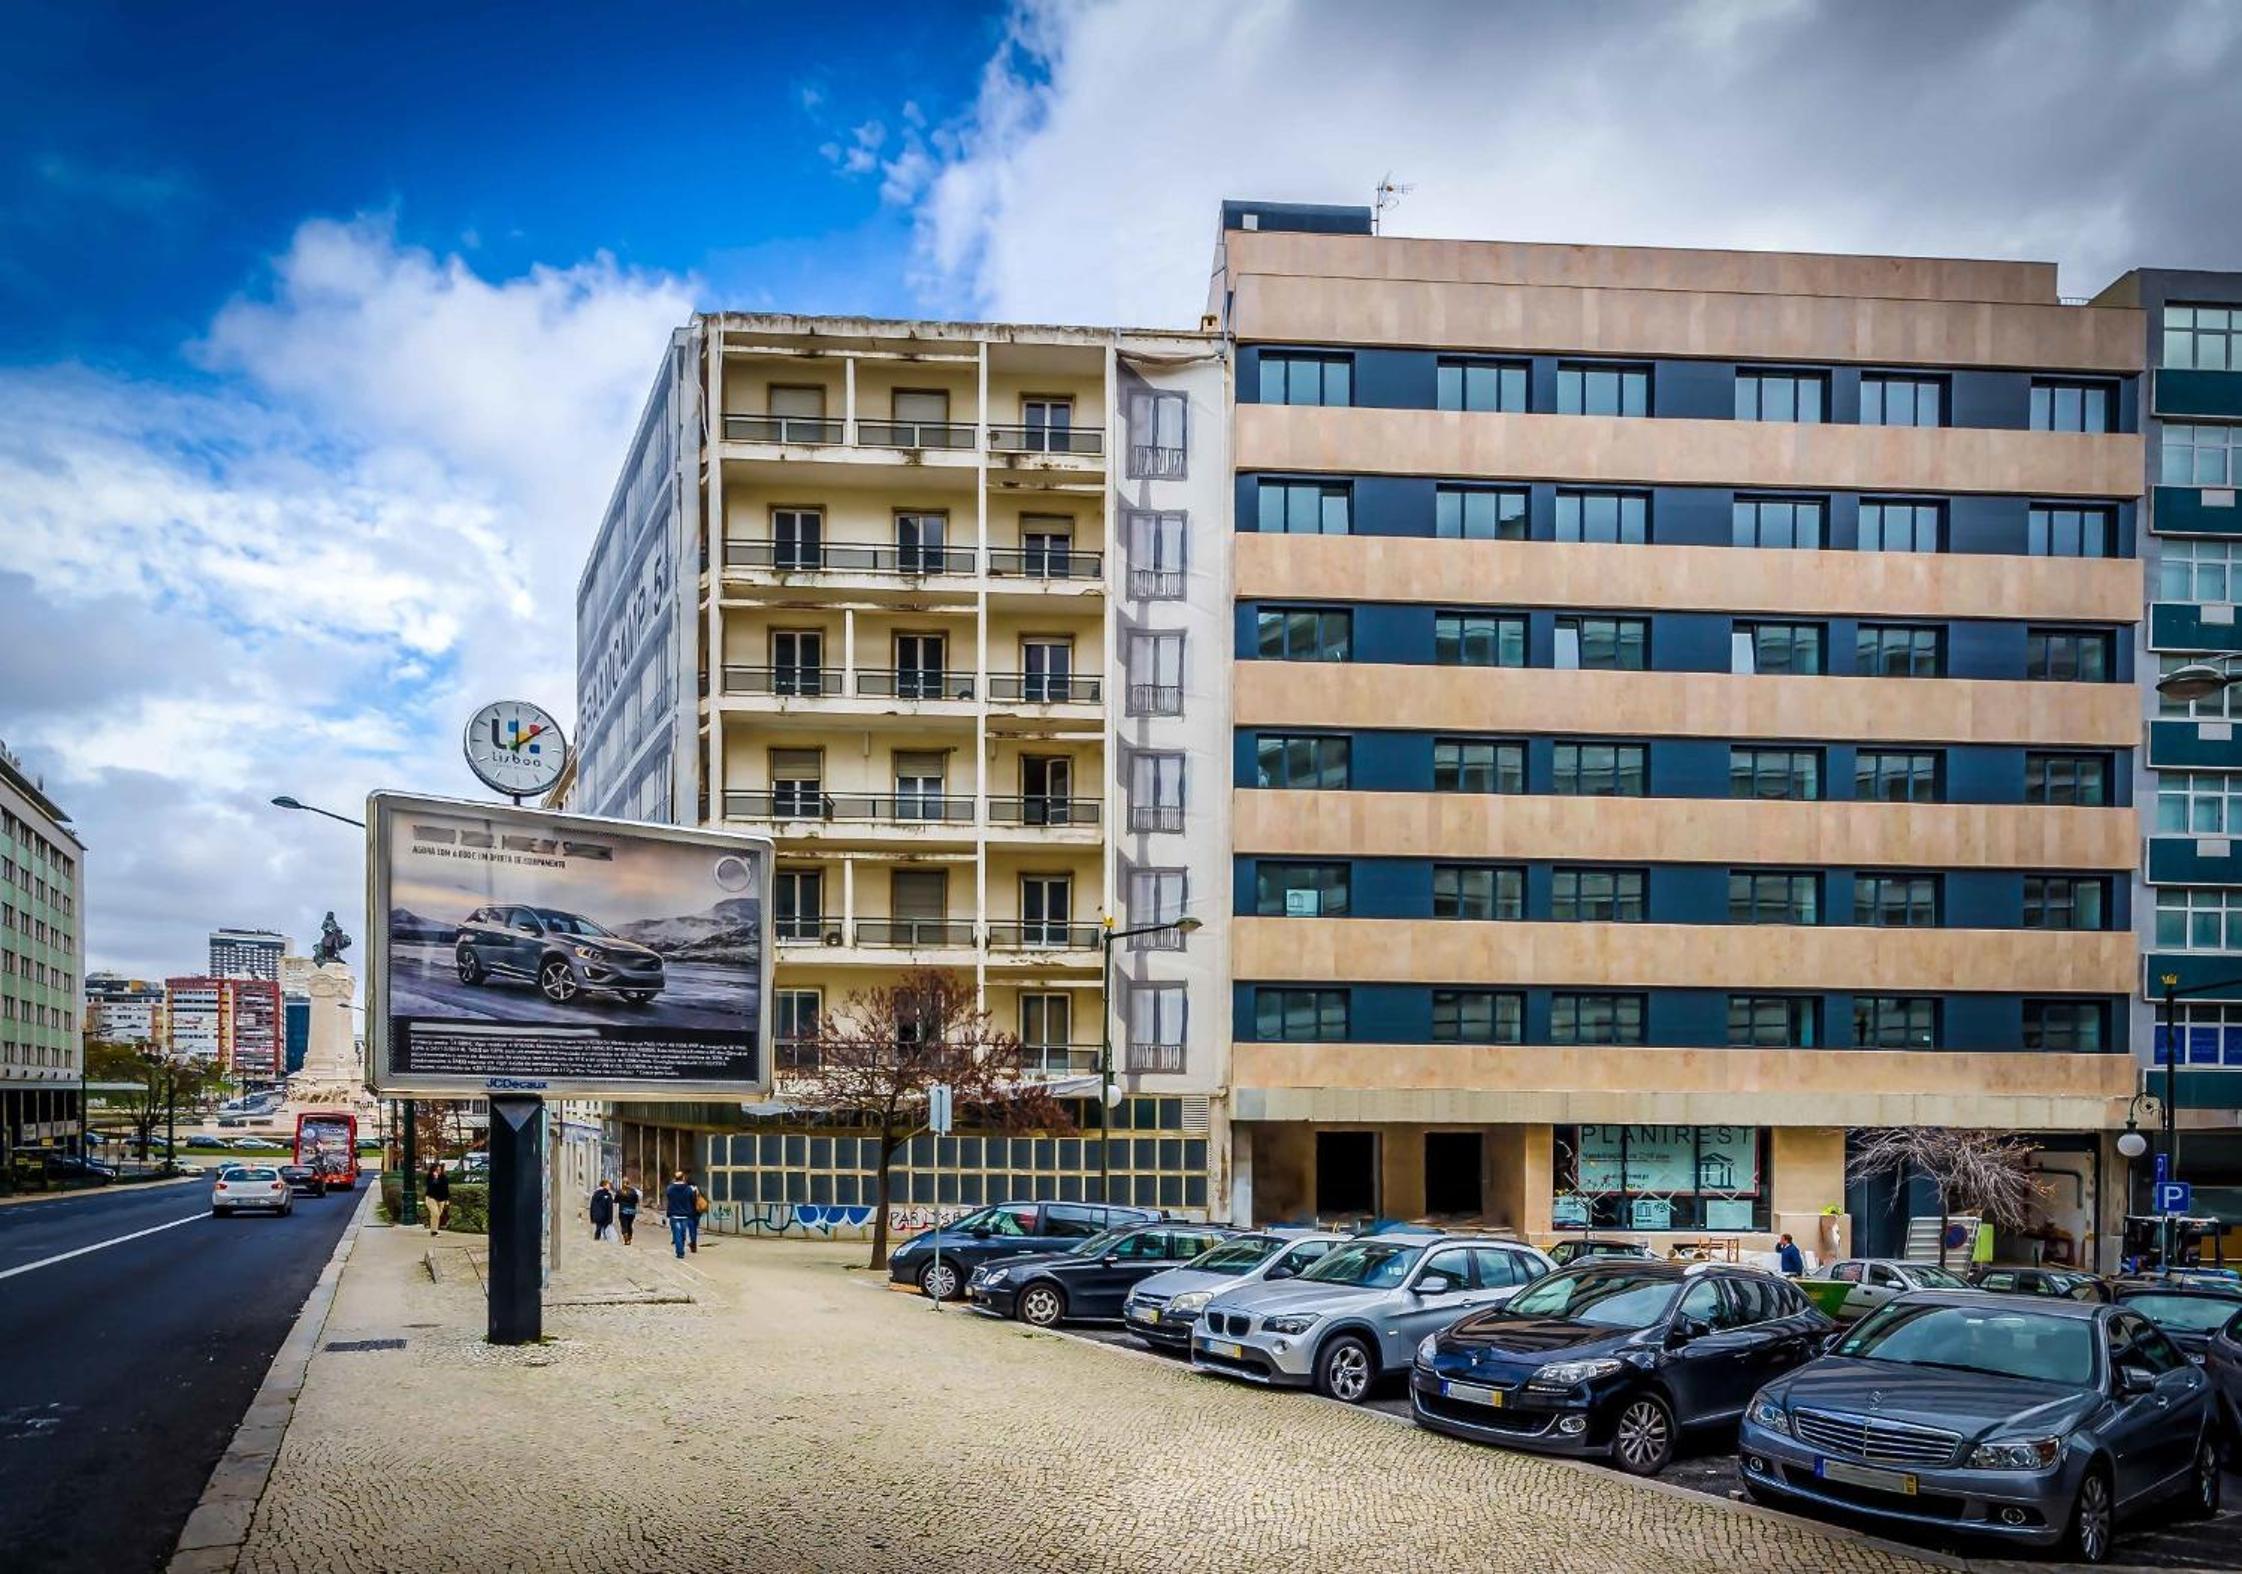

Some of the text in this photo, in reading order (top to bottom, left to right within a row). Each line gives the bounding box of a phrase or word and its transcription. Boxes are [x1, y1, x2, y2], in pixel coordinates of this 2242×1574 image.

[654, 554, 663, 617] 5
[492, 751, 541, 767] Lisboa
[486, 1077, 548, 1090] JCDecaux
[1581, 1126, 1752, 1145] PLANIREST
[2163, 1185, 2184, 1209] P
